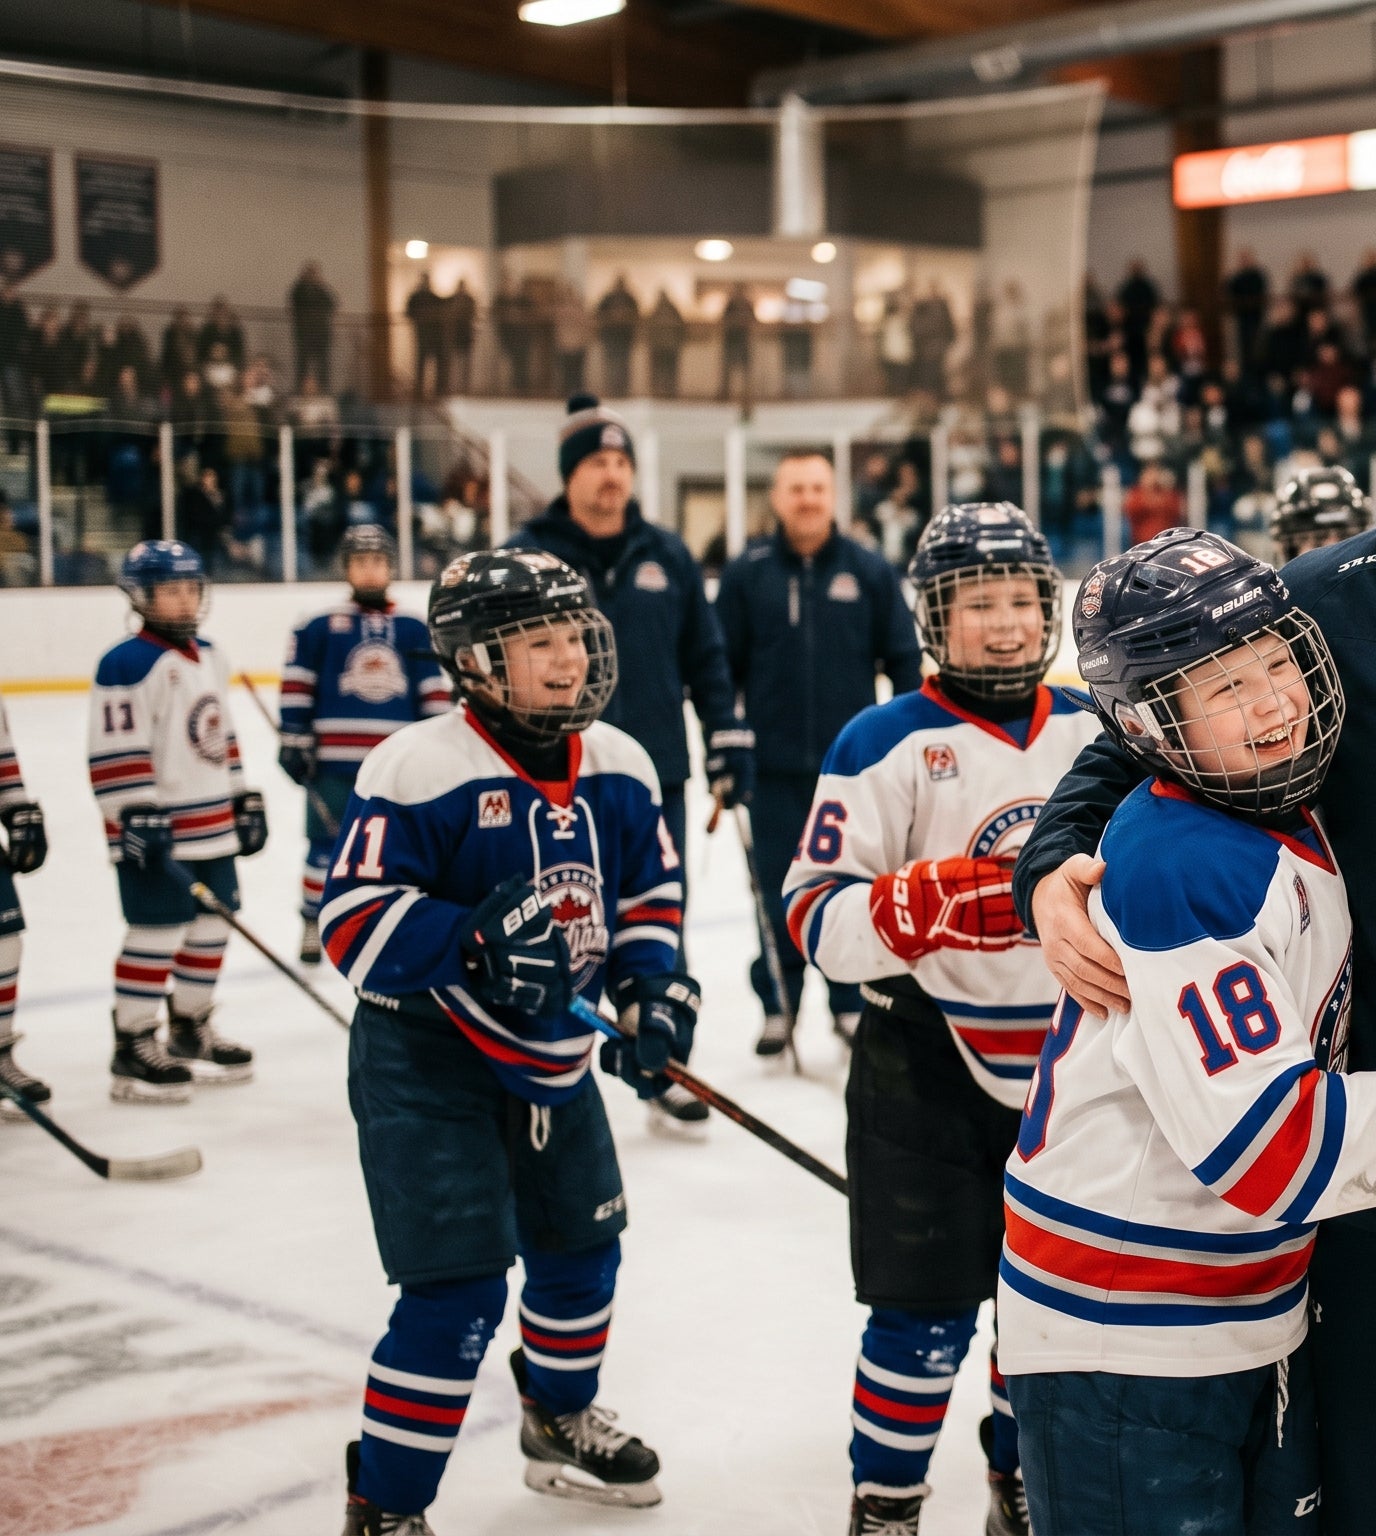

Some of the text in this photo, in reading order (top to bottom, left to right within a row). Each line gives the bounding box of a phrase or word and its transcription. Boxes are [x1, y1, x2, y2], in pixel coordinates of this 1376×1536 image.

[1180, 550, 1229, 576] 18
[1212, 586, 1262, 620] BAUER
[331, 815, 388, 879] 11
[794, 800, 848, 865] 6
[1178, 960, 1282, 1077] 18
[1294, 1490, 1322, 1518] C
